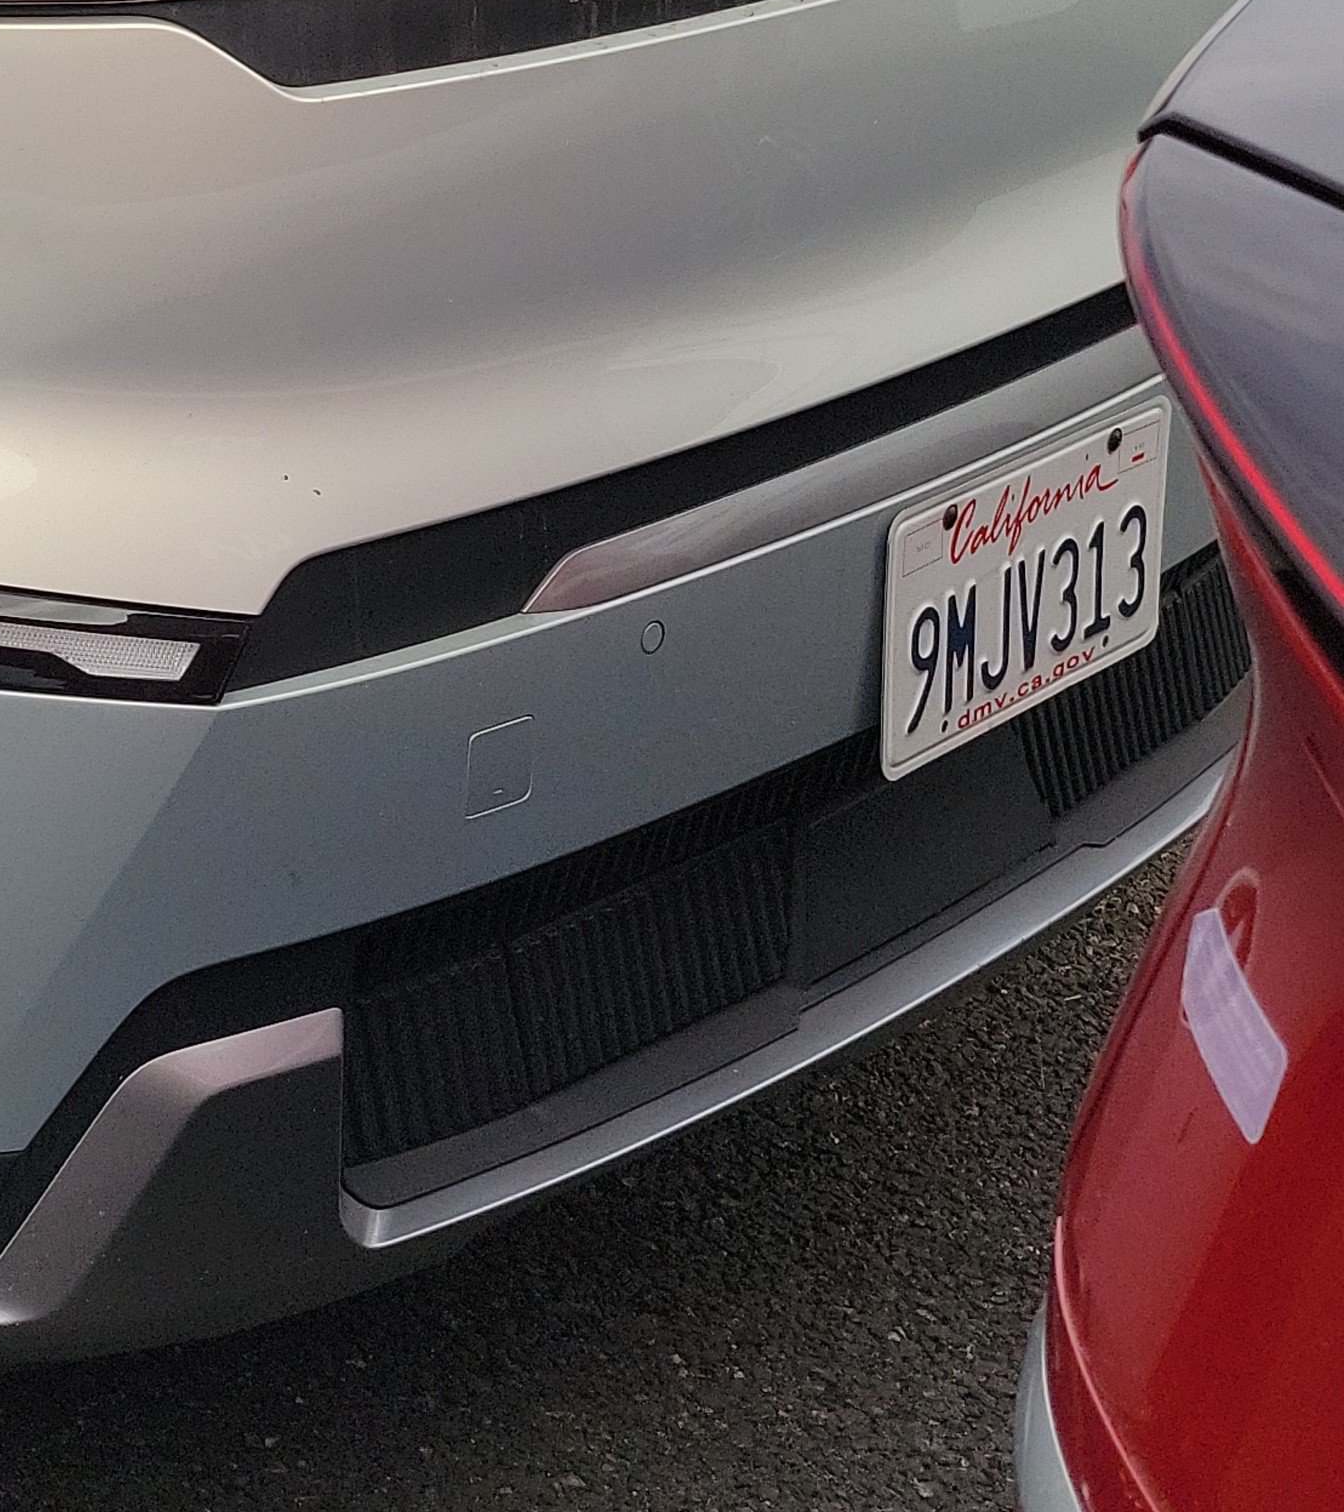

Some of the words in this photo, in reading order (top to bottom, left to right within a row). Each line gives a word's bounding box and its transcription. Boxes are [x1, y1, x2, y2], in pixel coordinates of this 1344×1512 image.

[949, 455, 1120, 565] California
[906, 503, 1147, 735] 9MJV313
[957, 648, 1095, 731] dmv.ca.gov
